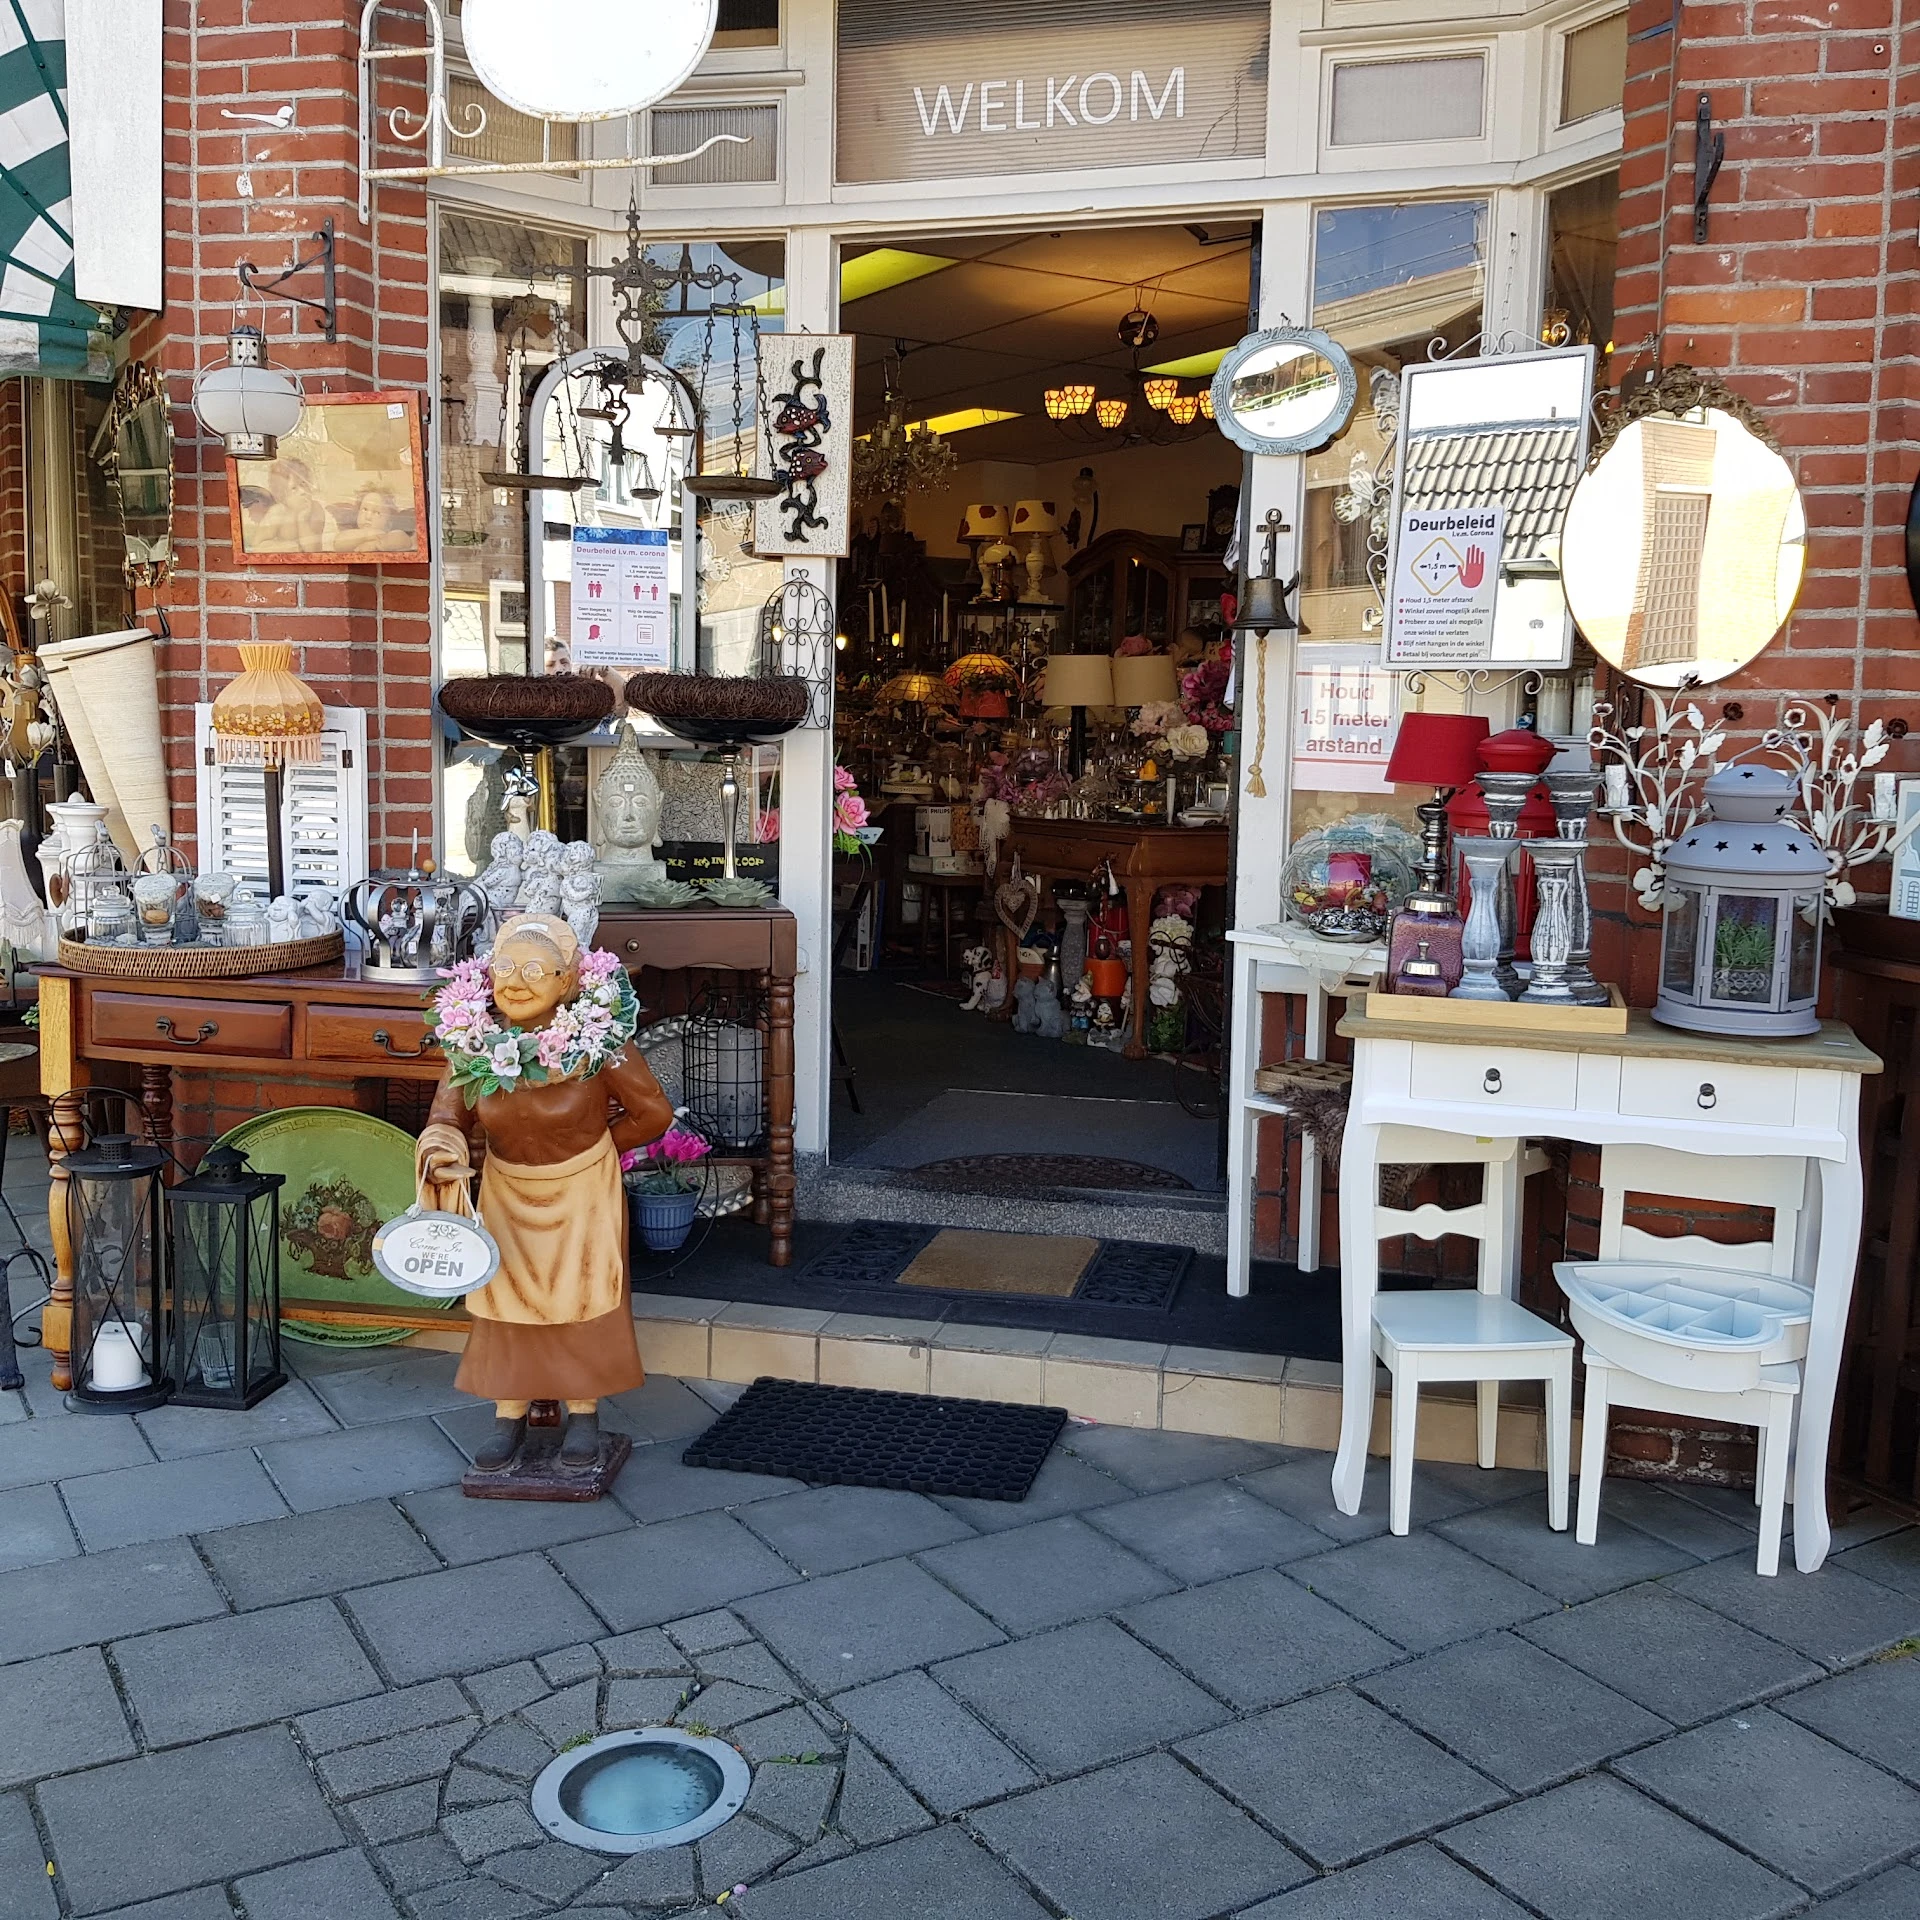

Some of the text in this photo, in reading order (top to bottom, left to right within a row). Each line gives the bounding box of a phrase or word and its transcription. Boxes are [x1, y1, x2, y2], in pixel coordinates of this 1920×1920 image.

[913, 66, 1185, 136] WELKOM
[1408, 514, 1496, 532] Deurbeleid
[576, 546, 616, 555] Deurbeleid
[1320, 682, 1375, 700] Houd
[1300, 708, 1392, 728] 1.5 meter
[1306, 736, 1382, 755] afstand
[409, 1236, 463, 1253] Come In
[422, 1252, 450, 1260] WE'RE
[404, 1257, 464, 1277] OPEN
